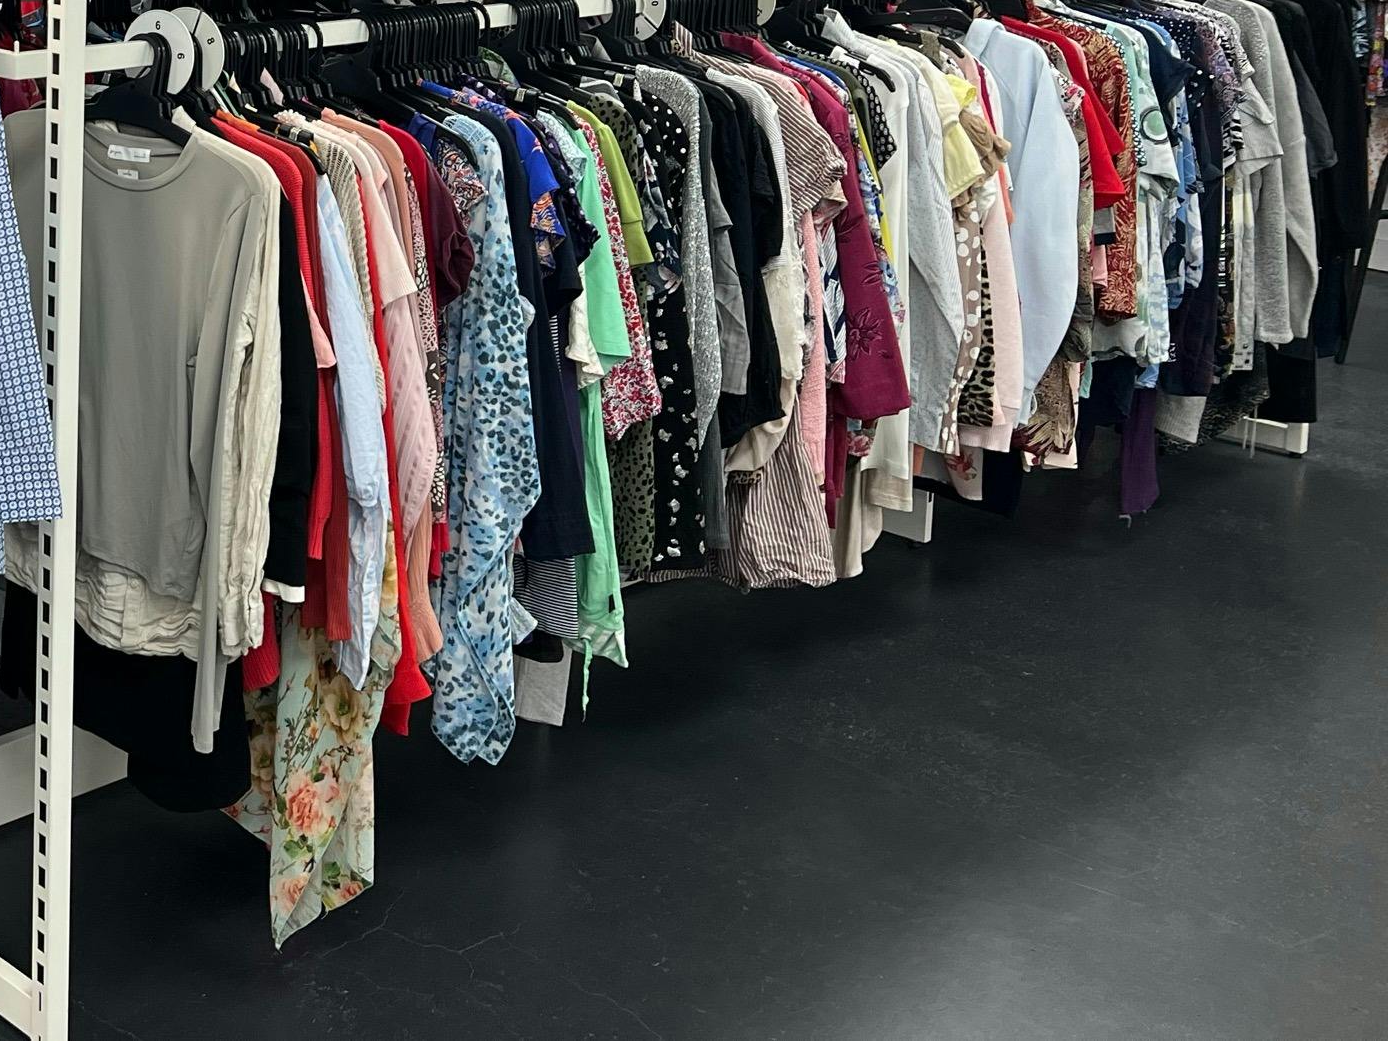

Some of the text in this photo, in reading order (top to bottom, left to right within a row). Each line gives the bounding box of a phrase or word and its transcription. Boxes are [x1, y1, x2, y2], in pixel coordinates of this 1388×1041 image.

[155, 20, 162, 31] 6
[206, 37, 216, 46] 8
[176, 52, 186, 60] 6
